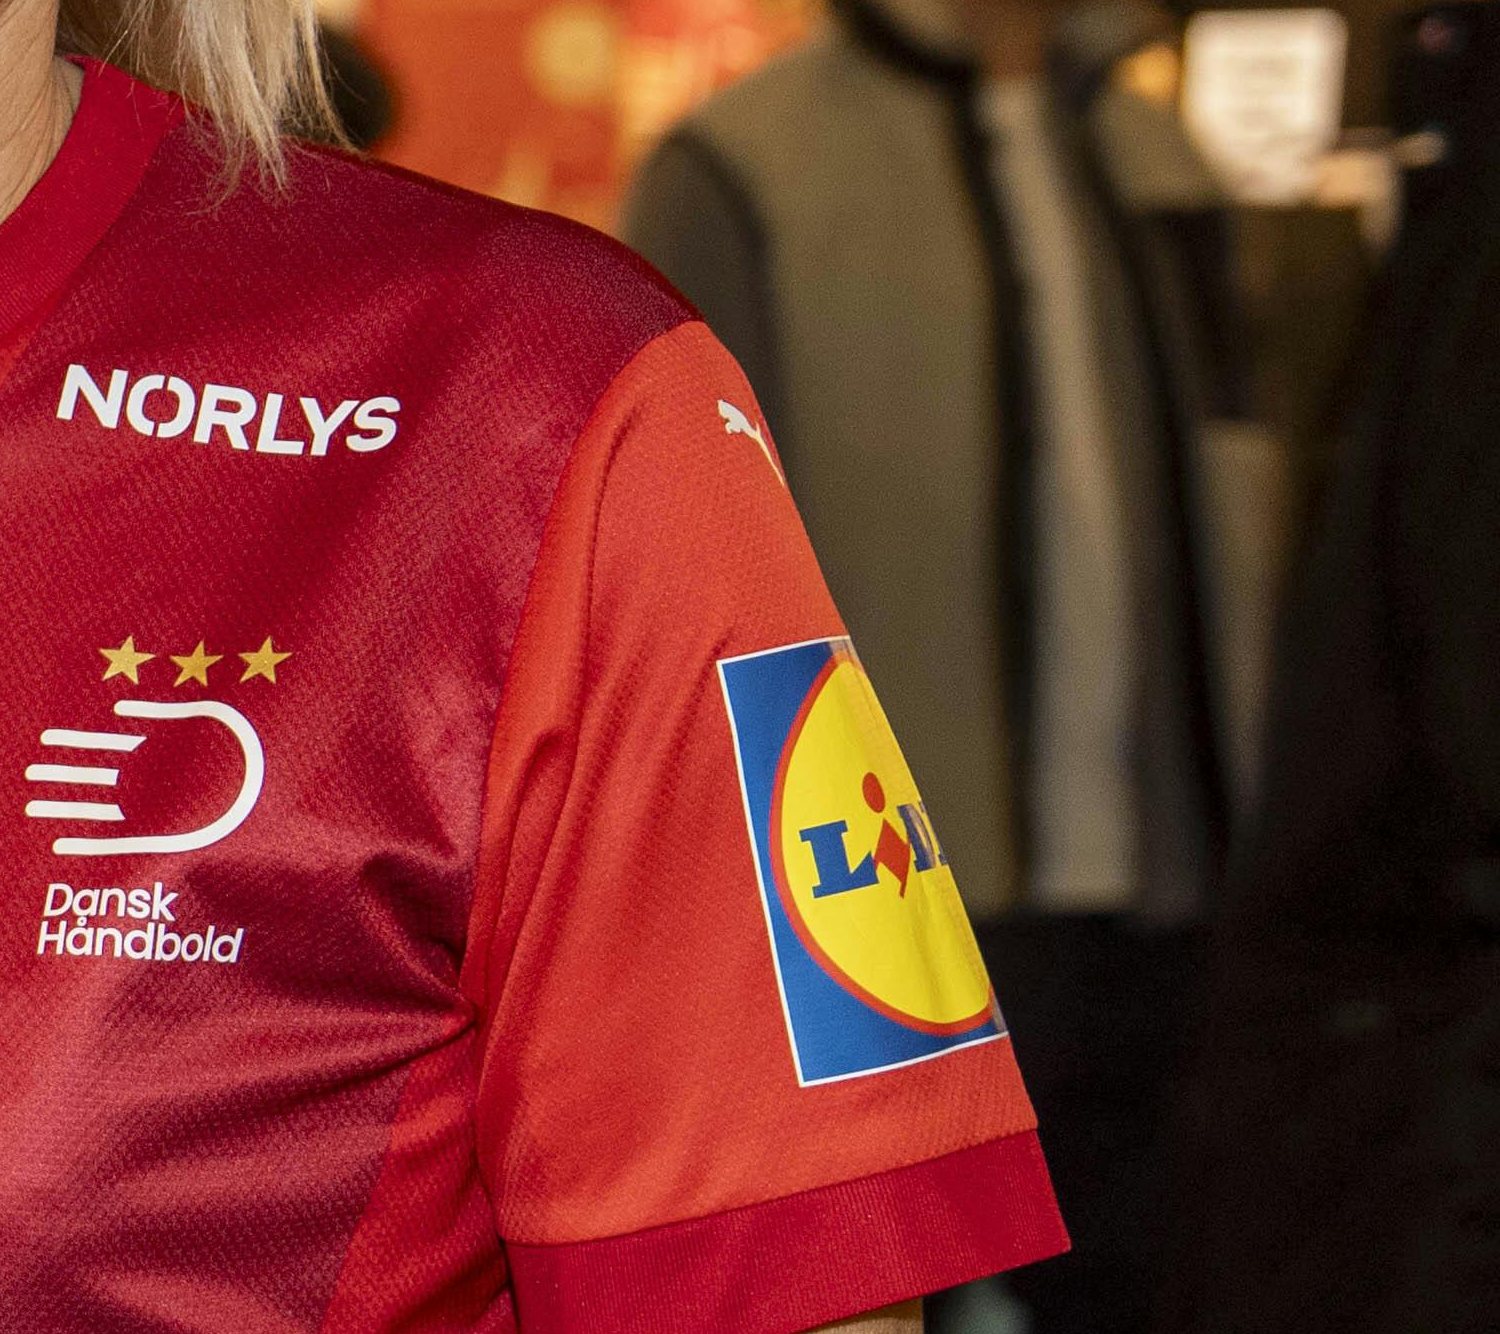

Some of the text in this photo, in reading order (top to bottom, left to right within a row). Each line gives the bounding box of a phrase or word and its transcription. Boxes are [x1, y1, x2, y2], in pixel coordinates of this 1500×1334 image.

[56, 364, 401, 456] NORLYS
[43, 882, 178, 921] Dansk
[37, 915, 245, 963] Håndbold
